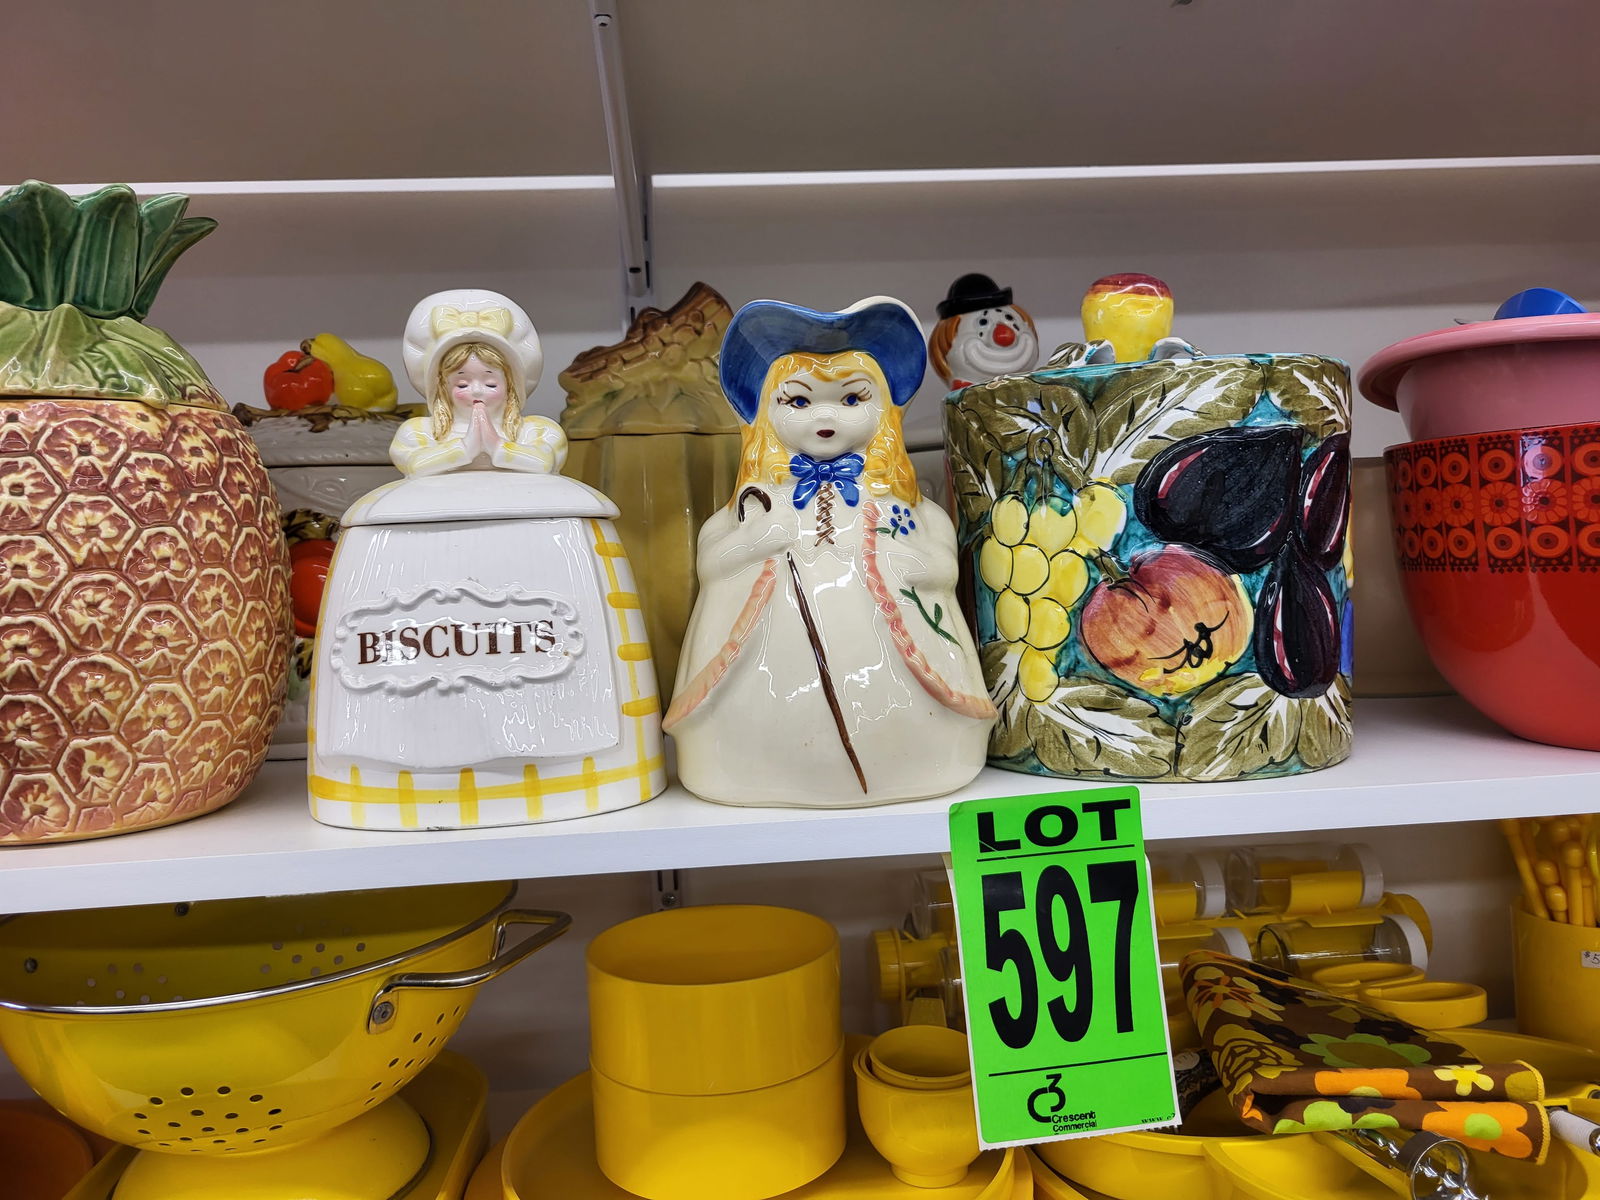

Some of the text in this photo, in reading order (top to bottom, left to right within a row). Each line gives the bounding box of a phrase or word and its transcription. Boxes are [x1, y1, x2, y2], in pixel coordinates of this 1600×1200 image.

[357, 620, 556, 665] BISCUITS
[976, 798, 1131, 854] LOT
[981, 860, 1139, 1049] 597
[1051, 1110, 1096, 1124] Crescent
[1053, 1120, 1098, 1133] Commercial
